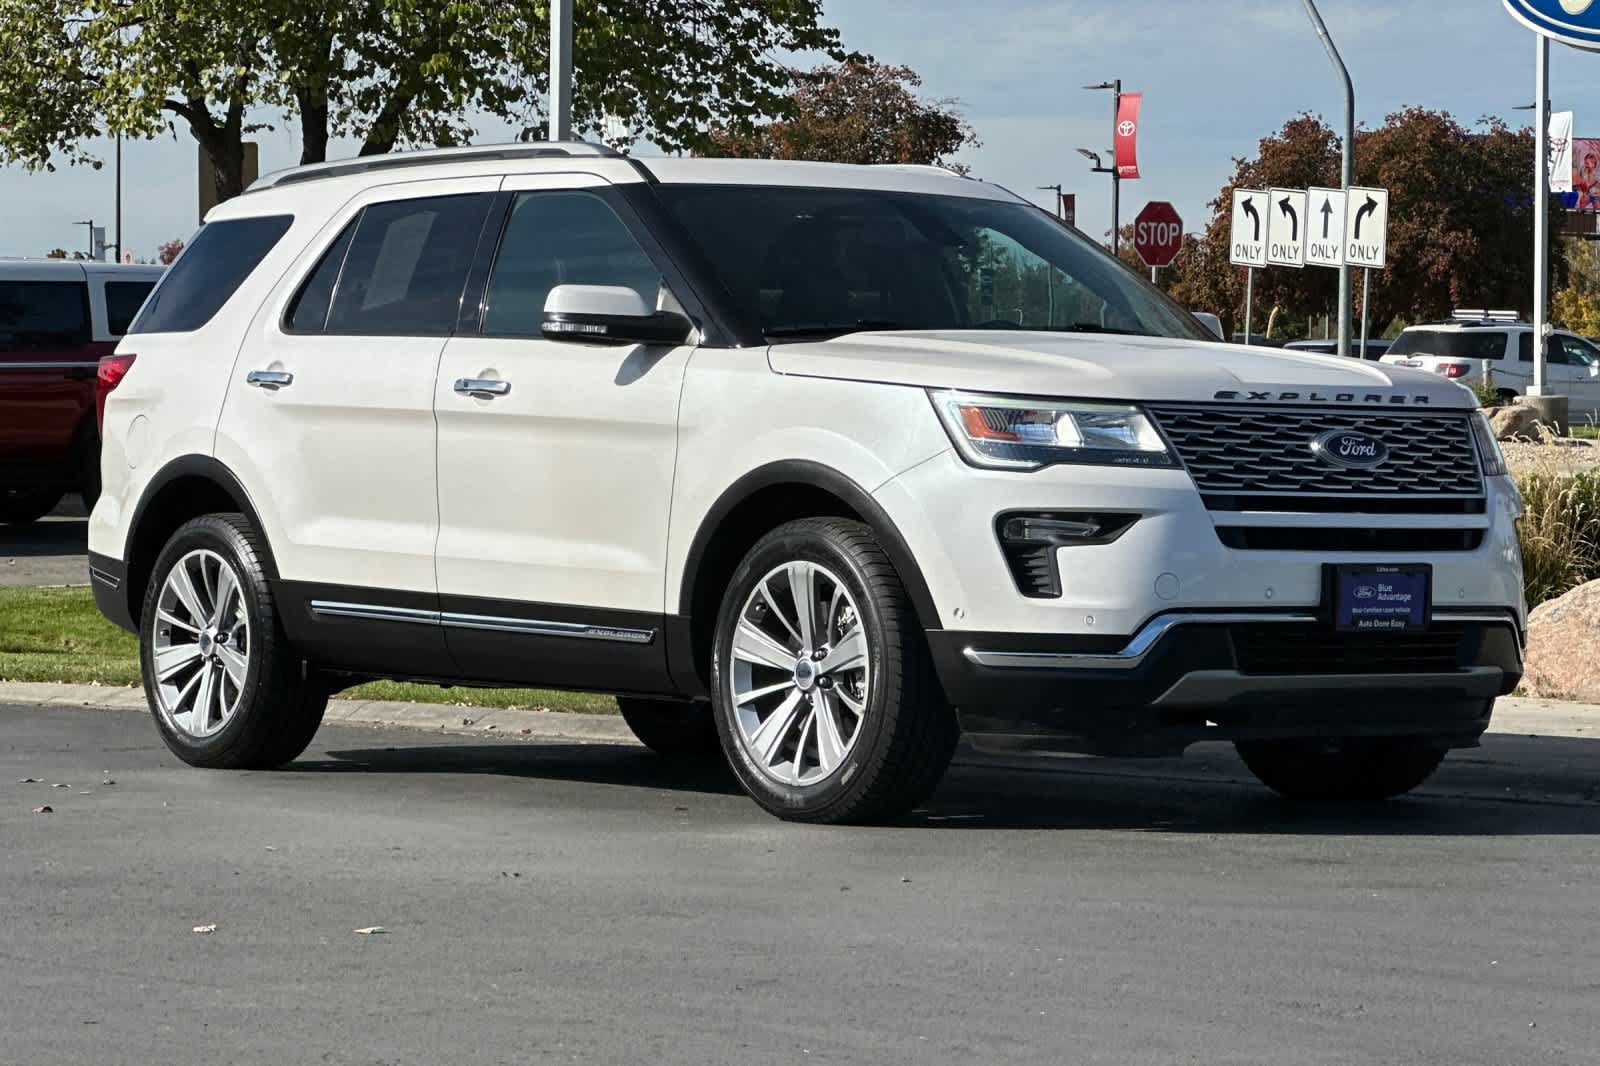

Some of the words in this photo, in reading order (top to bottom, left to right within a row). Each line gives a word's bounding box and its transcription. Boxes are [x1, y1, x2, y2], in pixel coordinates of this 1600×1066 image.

[1137, 221, 1180, 246] STOP
[1235, 243, 1261, 260] ONLY
[1271, 243, 1299, 260] ONLY
[1311, 243, 1338, 259] ONLY
[1350, 243, 1379, 260] ONLY
[1214, 390, 1429, 404] EXPLORER
[1339, 436, 1377, 457] Ford
[1377, 583, 1393, 592] Blue
[1377, 592, 1412, 602] Advantage
[1359, 620, 1372, 628] Auto
[1391, 620, 1406, 629] Easy
